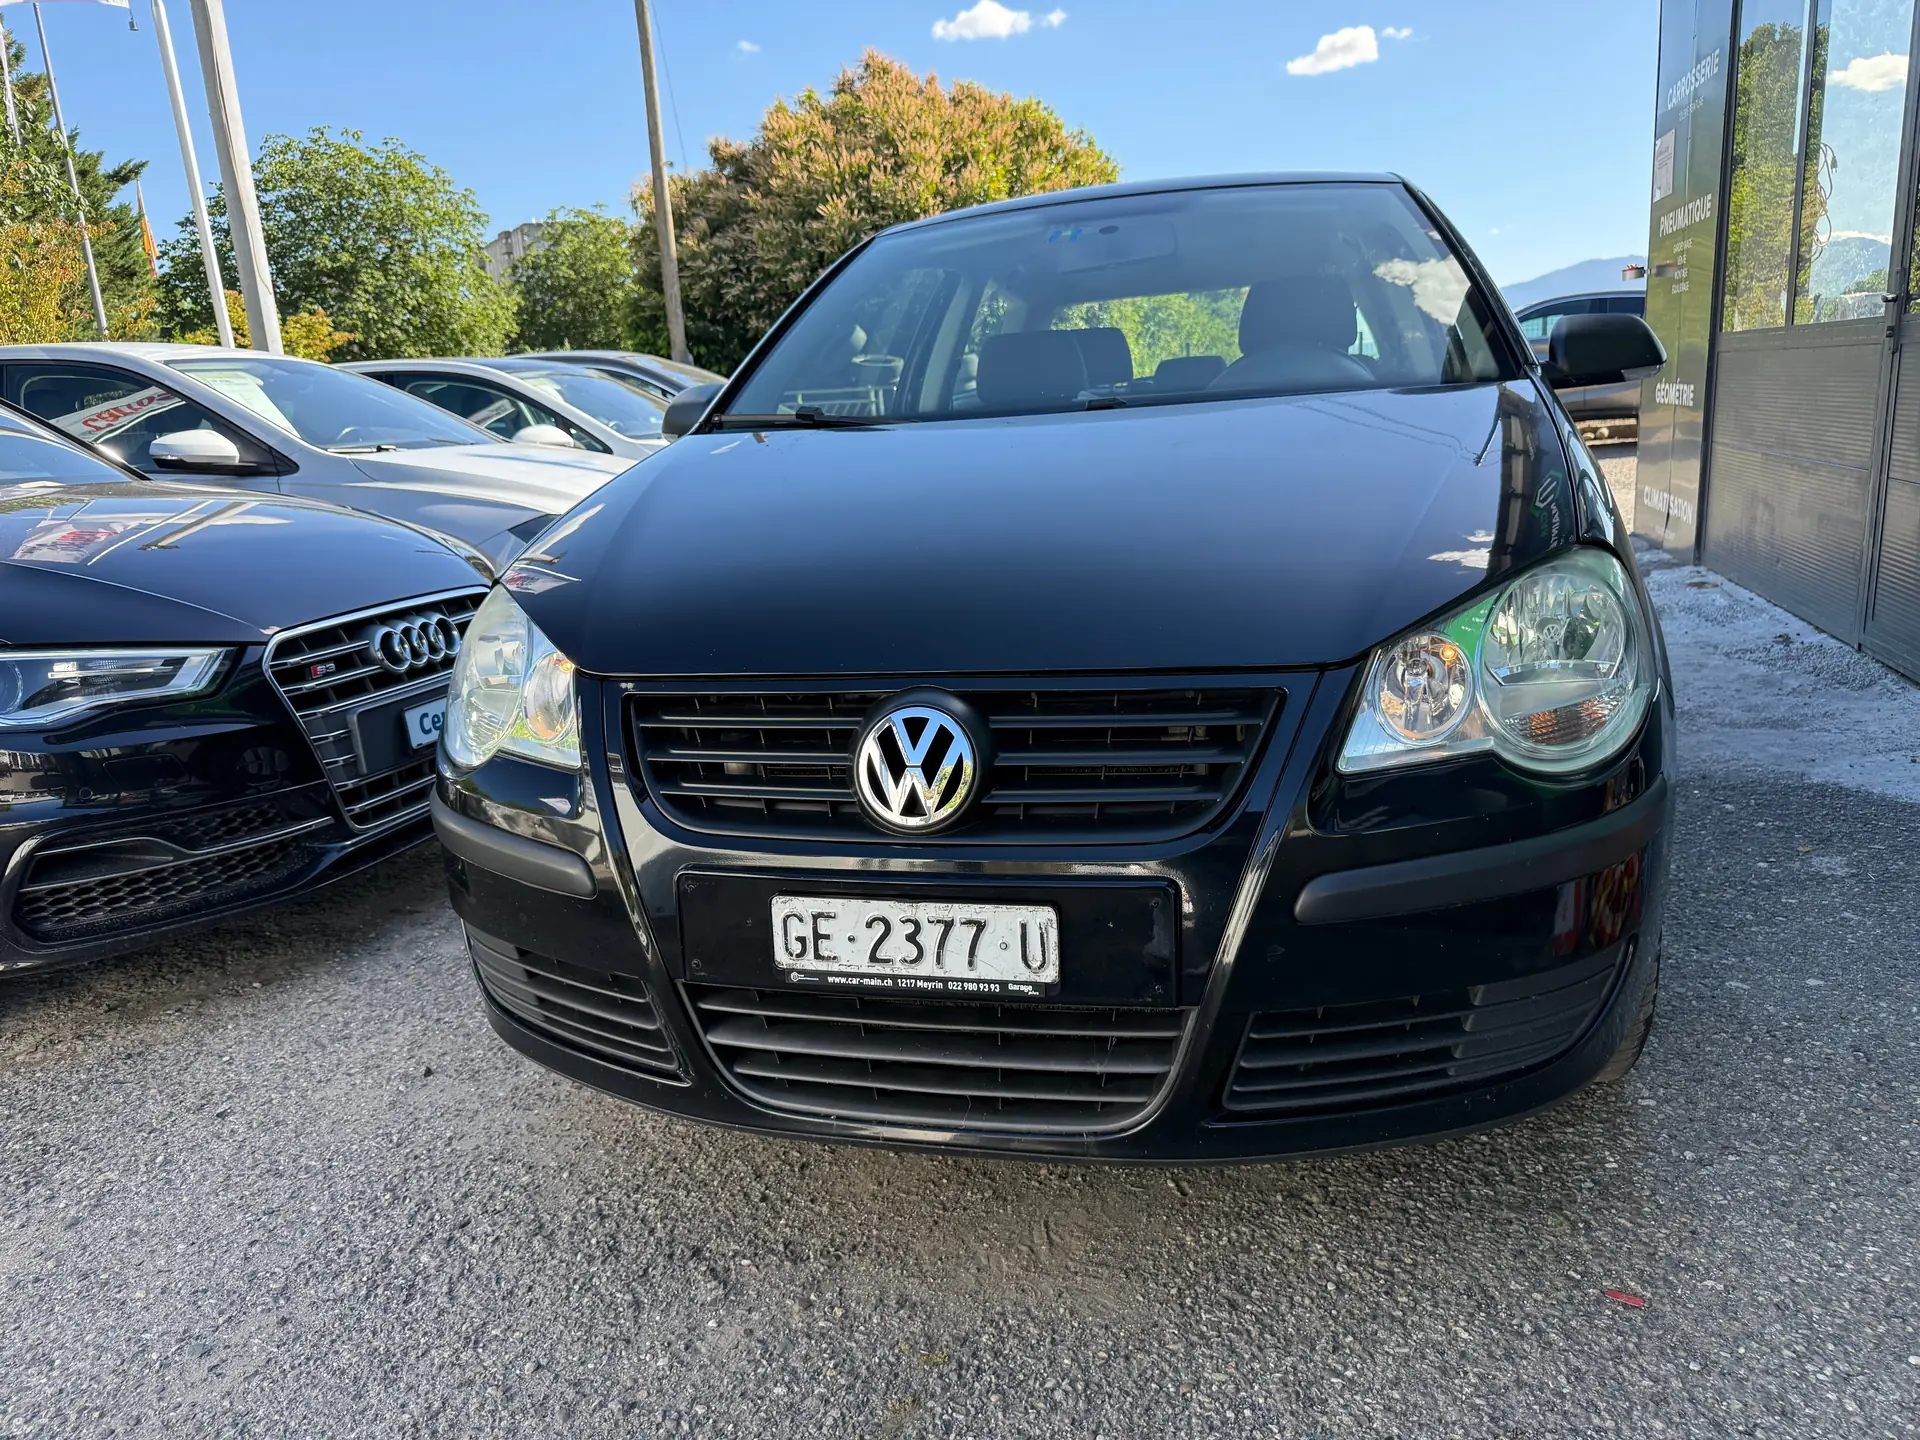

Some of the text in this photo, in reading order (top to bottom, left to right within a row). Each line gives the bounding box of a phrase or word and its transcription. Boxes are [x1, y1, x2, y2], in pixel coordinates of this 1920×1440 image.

[1667, 47, 1720, 111] CARROSSERIE
[1659, 193, 1712, 238] PNEUMATIQUE
[1655, 377, 1695, 407] GÉOMÉTRIE
[865, 915, 987, 971] 2377
[1019, 918, 1048, 973] U
[827, 975, 893, 987] www.car-main.ch
[897, 978, 915, 988] 1217
[917, 979, 944, 991] Meyrin
[947, 981, 963, 991] 022
[963, 981, 978, 991] 980
[978, 982, 989, 992] 93
[990, 983, 1000, 993] 93
[1008, 983, 1033, 993] Garage
